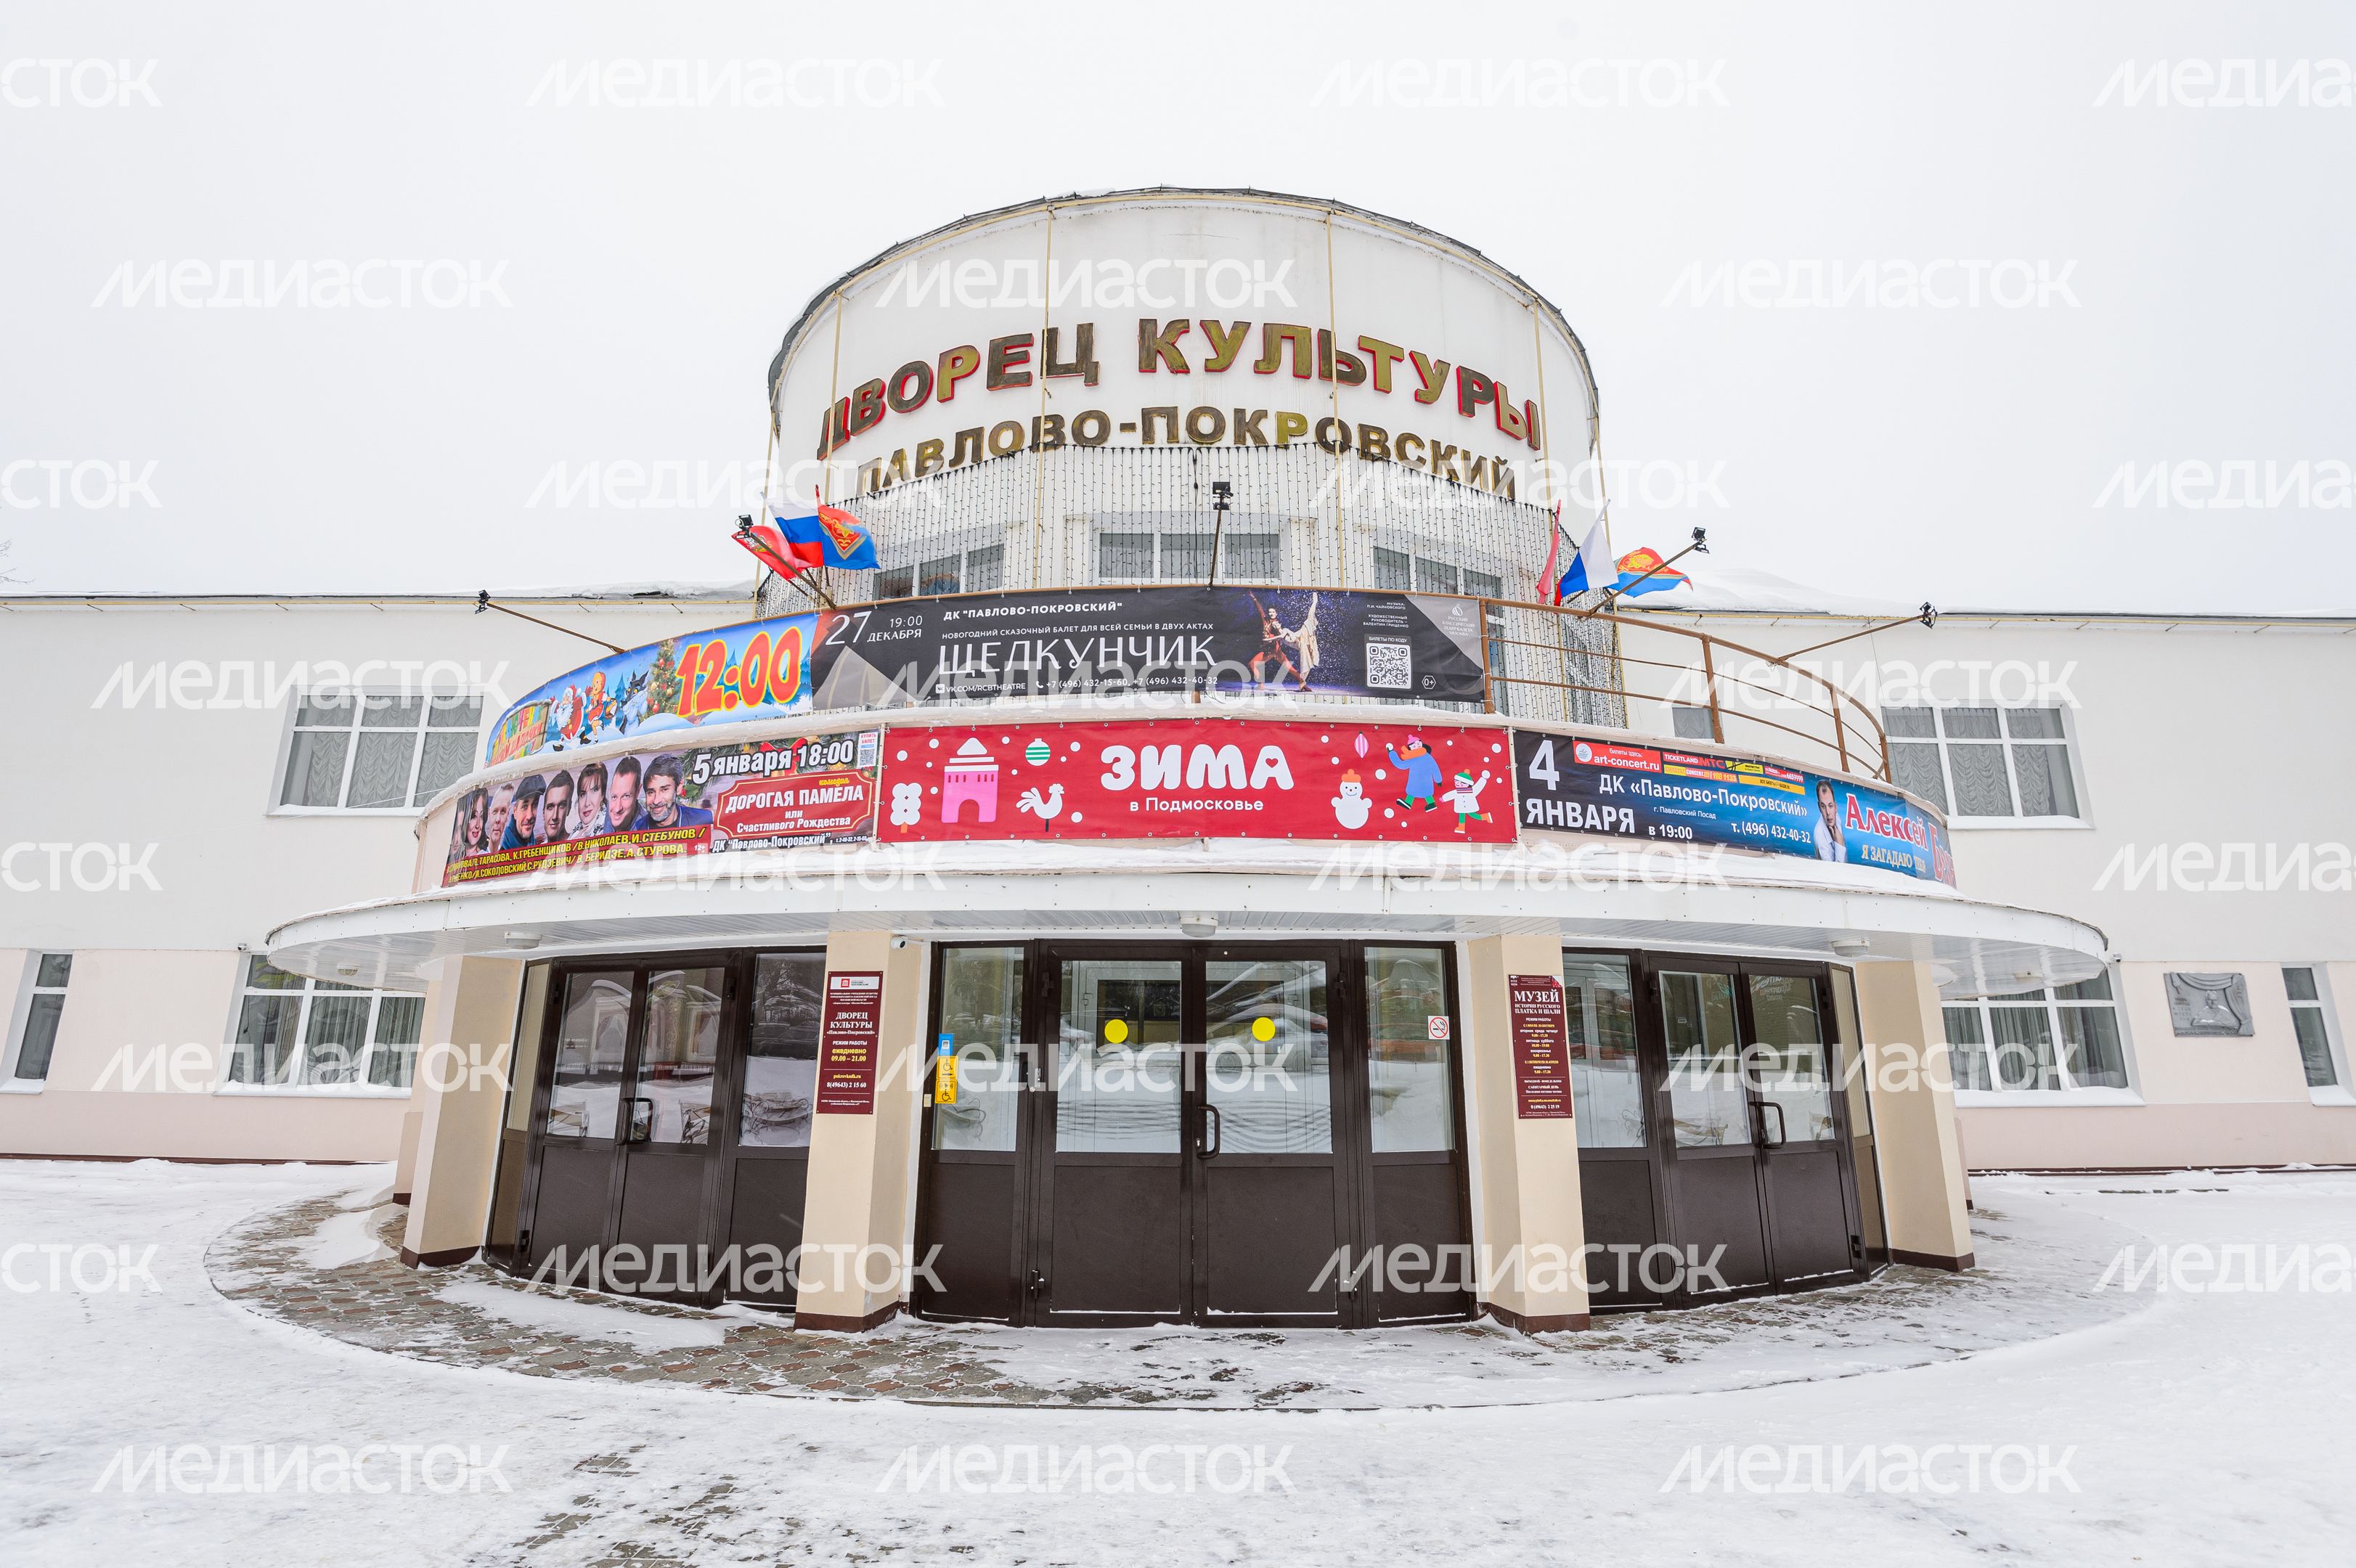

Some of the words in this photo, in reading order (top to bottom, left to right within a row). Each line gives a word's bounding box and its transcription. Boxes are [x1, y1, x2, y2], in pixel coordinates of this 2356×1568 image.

[817, 322, 1099, 460] ДВОРЕЦ
[1138, 318, 1541, 450] КУЛЬТУРЫ
[855, 405, 1517, 502] ПАВЛОВО-ПОКРОВСКИЙ
[943, 610, 961, 621] ДК
[963, 601, 1122, 618] "ПАВЛОВО-ПОКРОВСКИЙ"
[825, 611, 872, 646] 27
[889, 615, 923, 629] 19:00
[867, 628, 922, 643] ДЕКАБРЯ
[942, 629, 998, 640] НОВОГОДНИЙ
[1000, 626, 1051, 637] СКАЗОЧНЫЙ
[1053, 625, 1079, 634] БАЛЕТ
[1080, 625, 1098, 634] ДЛЯ
[1099, 623, 1124, 633] ВСЕЙ
[1125, 624, 1153, 632] СЕМЬИ
[1161, 623, 1184, 632] ДВУХ
[939, 635, 1218, 677] ЩЕЛКУНЧИК
[674, 626, 802, 719] 12:00
[946, 682, 1026, 694] VK.COM/RCBTHEATRE
[1046, 680, 1057, 689] +7
[1059, 679, 1082, 689] (496)
[1084, 677, 1130, 688] 432-15-60,
[1133, 678, 1144, 687] +7
[1145, 677, 1169, 686] (496)
[1171, 676, 1218, 685] 432-40-32
[1424, 677, 1435, 687] 0+
[1609, 747, 1629, 756] билеты
[1629, 750, 1644, 759] здесь:
[1664, 754, 1698, 764] TICKETLAND
[692, 753, 712, 785] 5
[712, 749, 793, 777] января
[797, 739, 855, 767] 18:00
[1099, 743, 1296, 791] ЗИМА
[1529, 739, 1560, 791] 4
[1594, 754, 1660, 771] art-concert.ru
[1698, 758, 1726, 769] МТС
[725, 790, 795, 814] ДОРОГАЯ
[799, 785, 864, 806] ПАМЕЛА
[1599, 775, 1623, 794] ДК
[1631, 780, 1807, 817] «Павлово-Покровский»
[1130, 801, 1139, 812] в
[1145, 796, 1264, 814] Подмосковье
[1660, 806, 1697, 818] Павловский
[1697, 810, 1716, 820] Посад
[785, 810, 803, 820] или
[1525, 798, 1636, 834] ЯНВАРЯ
[1845, 793, 1928, 852] Алексей
[737, 821, 795, 833] Счастливого
[797, 817, 850, 829] Рождества
[1648, 826, 1656, 836] в
[1659, 824, 1693, 840] 19:00
[1731, 822, 1740, 833] т.
[1742, 820, 1769, 838] (496)
[1771, 825, 1811, 844] 432-40-32
[712, 839, 725, 853] ДК
[479, 852, 512, 866] ТАРАСОВА,
[1862, 845, 1869, 859] Я
[1870, 847, 1913, 869] ЗАГАДАЮ
[1514, 989, 1560, 1003] МУЗЕЙ
